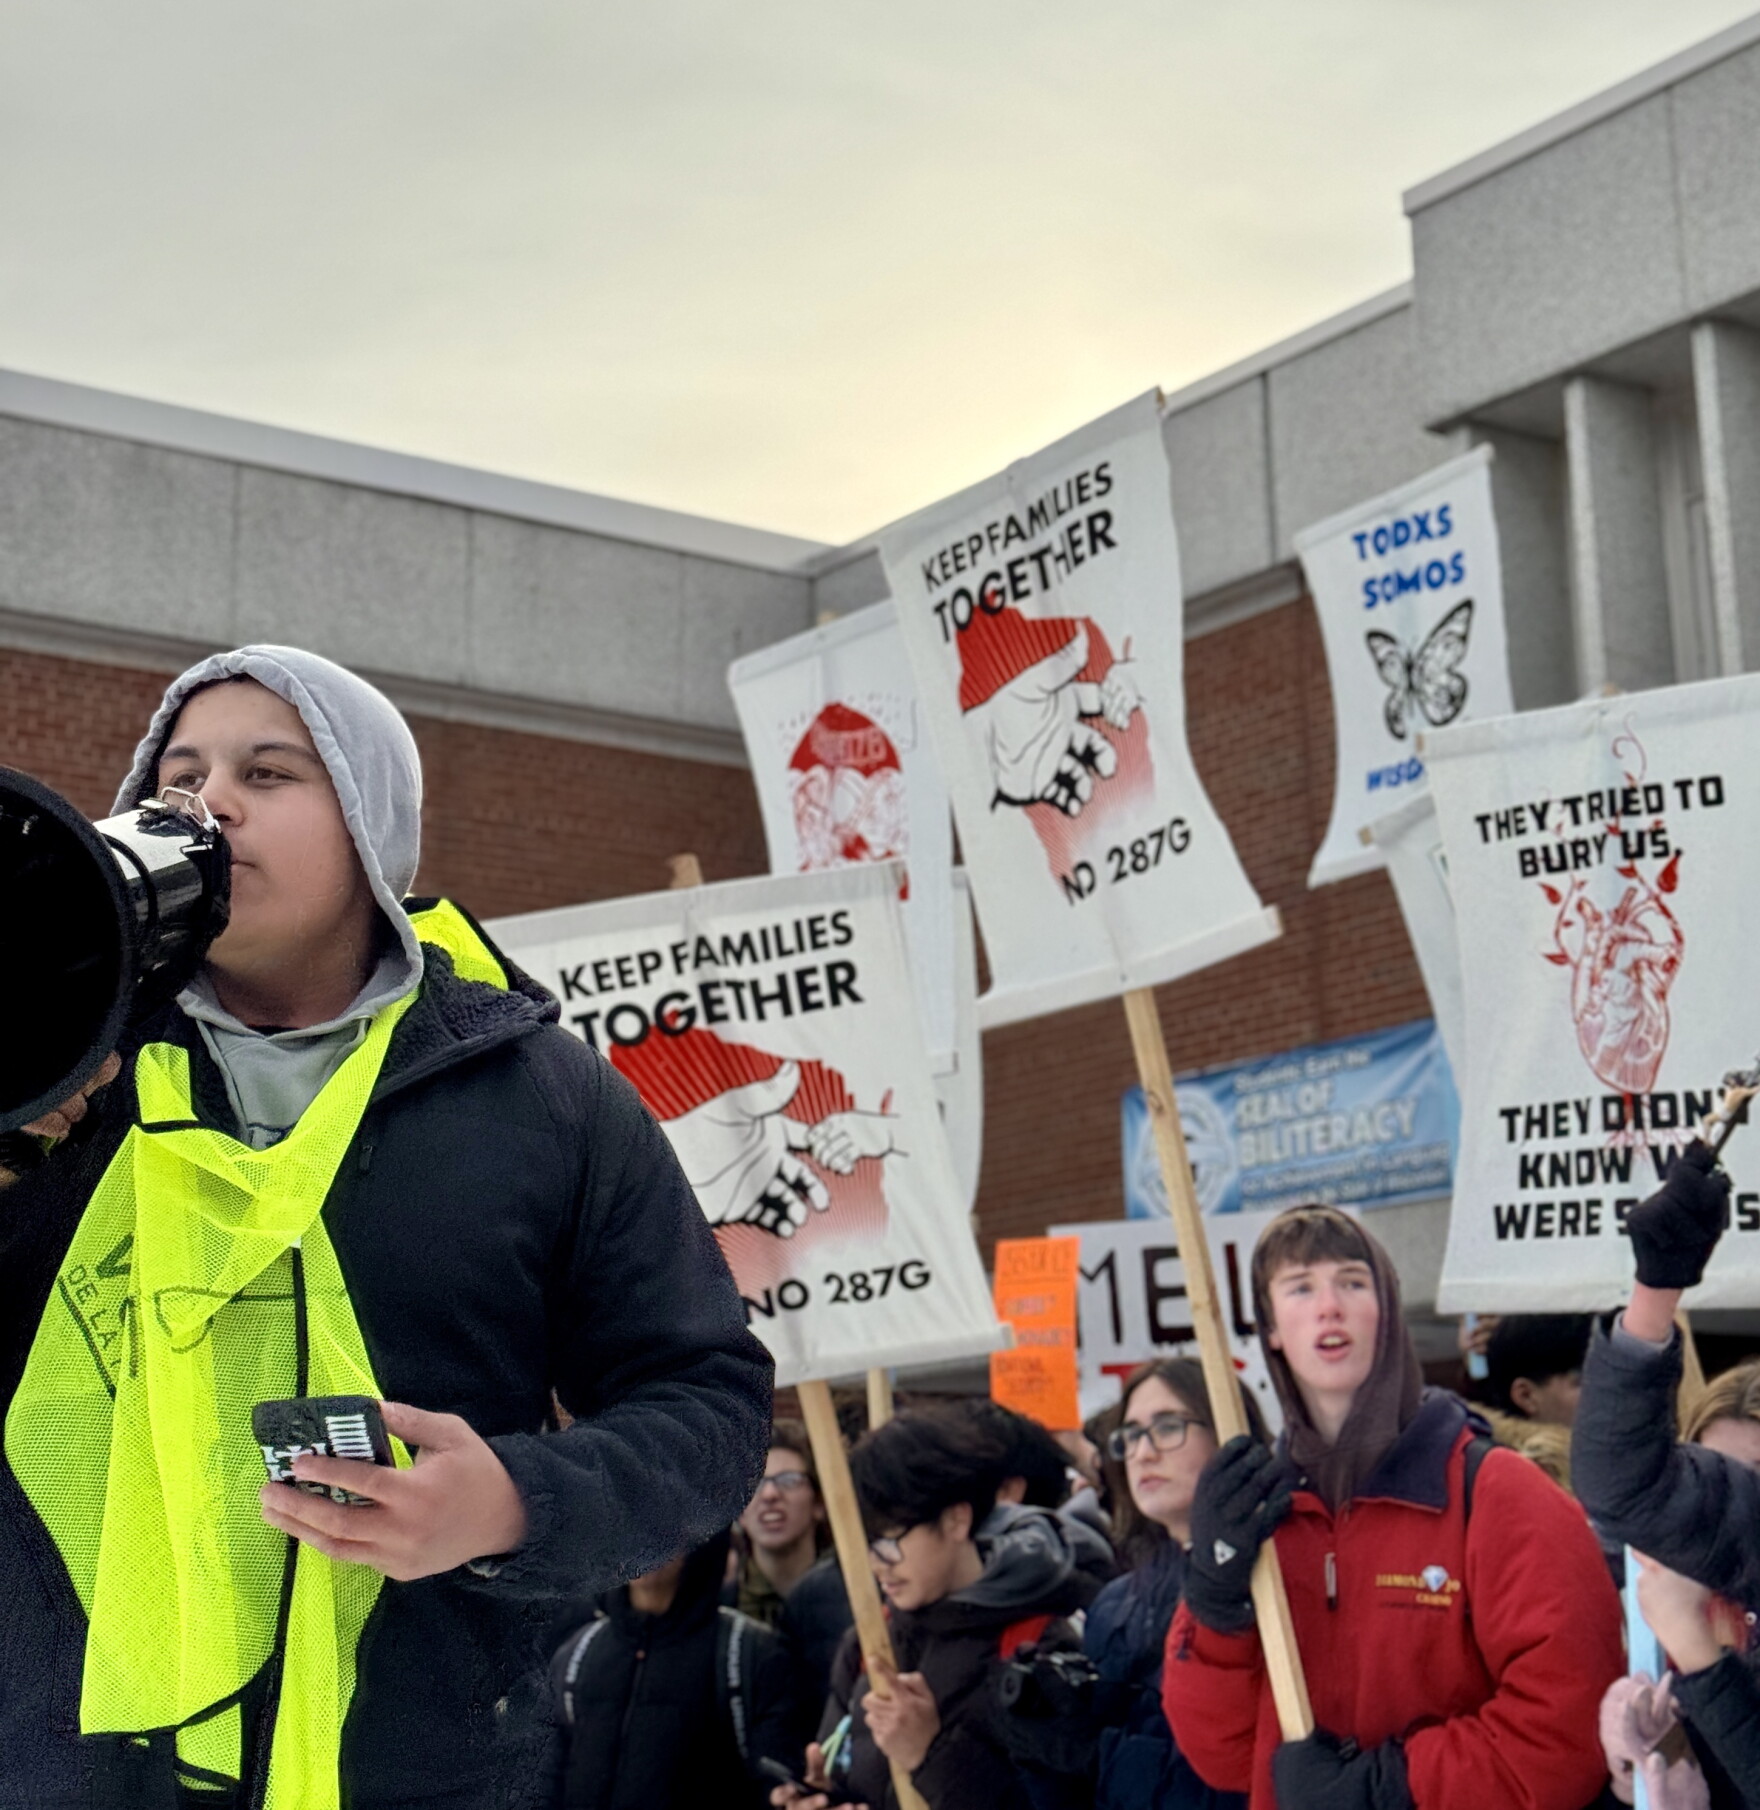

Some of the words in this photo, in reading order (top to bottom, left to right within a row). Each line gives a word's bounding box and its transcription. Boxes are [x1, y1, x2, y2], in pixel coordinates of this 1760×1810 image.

[921, 533, 984, 593] KEEP
[986, 461, 1115, 553] FAMILIES
[1352, 504, 1453, 561] TODXS
[933, 508, 1117, 643] TOGETHER
[1363, 551, 1466, 611] SOMOS
[1475, 799, 1551, 845] THEY
[1563, 784, 1665, 827] TRIED
[1673, 774, 1726, 812] TO
[1059, 859, 1097, 906] NO
[1106, 817, 1193, 885] 287G
[1519, 834, 1608, 878] BURY
[559, 950, 664, 1003] KEEP
[669, 910, 855, 977] FAMILIES
[572, 959, 866, 1050] TOGETHER
[1499, 1096, 1592, 1144] THEY
[1601, 1087, 1750, 1133] DIDN'
[1519, 1145, 1633, 1190] KNOW
[1493, 1199, 1603, 1241] WERE
[743, 1279, 810, 1327] NO
[823, 1258, 932, 1304] 287G
[1077, 1242, 1257, 1347] MEL
